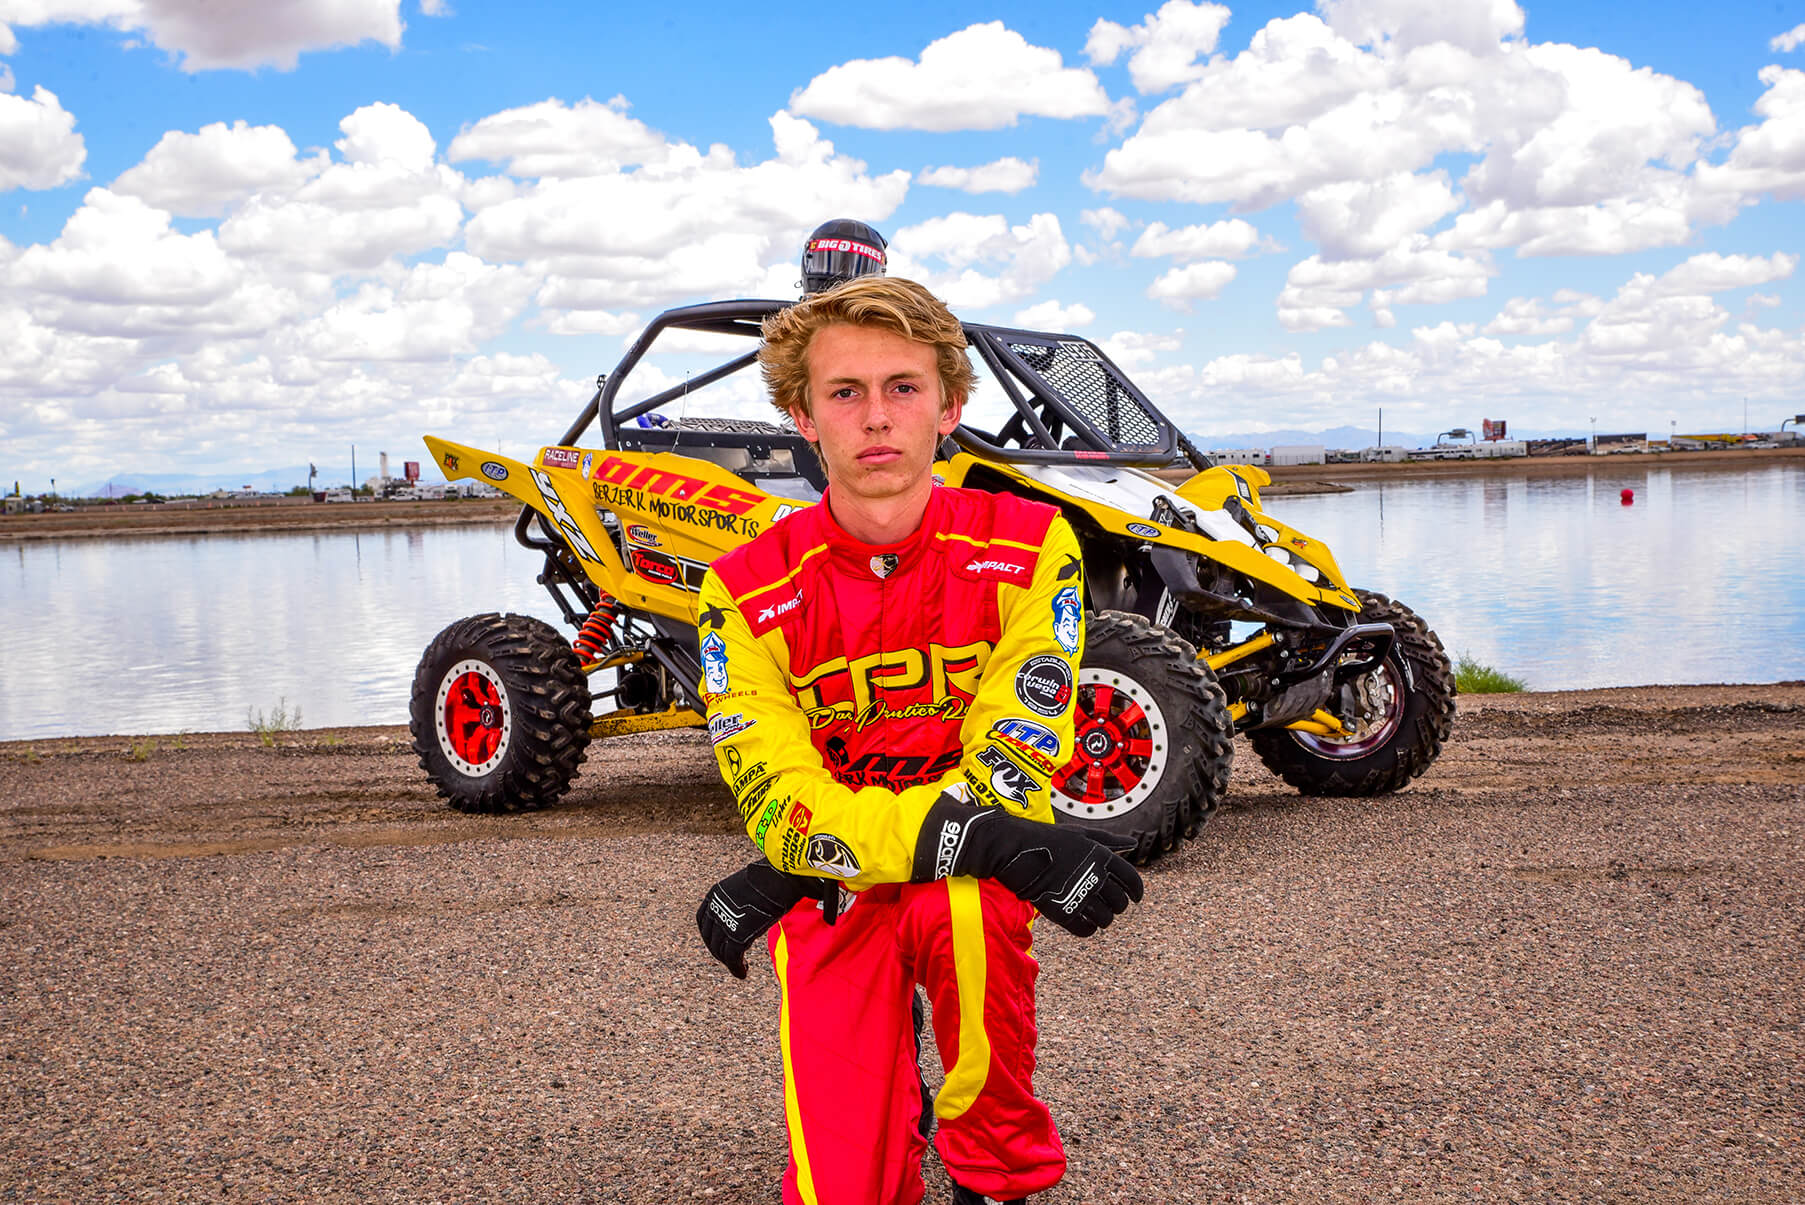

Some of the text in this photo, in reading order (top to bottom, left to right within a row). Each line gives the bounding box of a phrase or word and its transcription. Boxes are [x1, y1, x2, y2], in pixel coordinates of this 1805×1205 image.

[817, 240, 839, 249] BIG
[851, 242, 882, 261] TIRES
[544, 449, 580, 463] RACELINE
[592, 481, 760, 538] BERZERK MOTORSPORTS
[715, 690, 758, 704] WHEELS
[1000, 722, 1058, 751] ITP
[976, 745, 1042, 800] FOX
[1065, 873, 1099, 914] sparco
[710, 901, 738, 932] sparco
